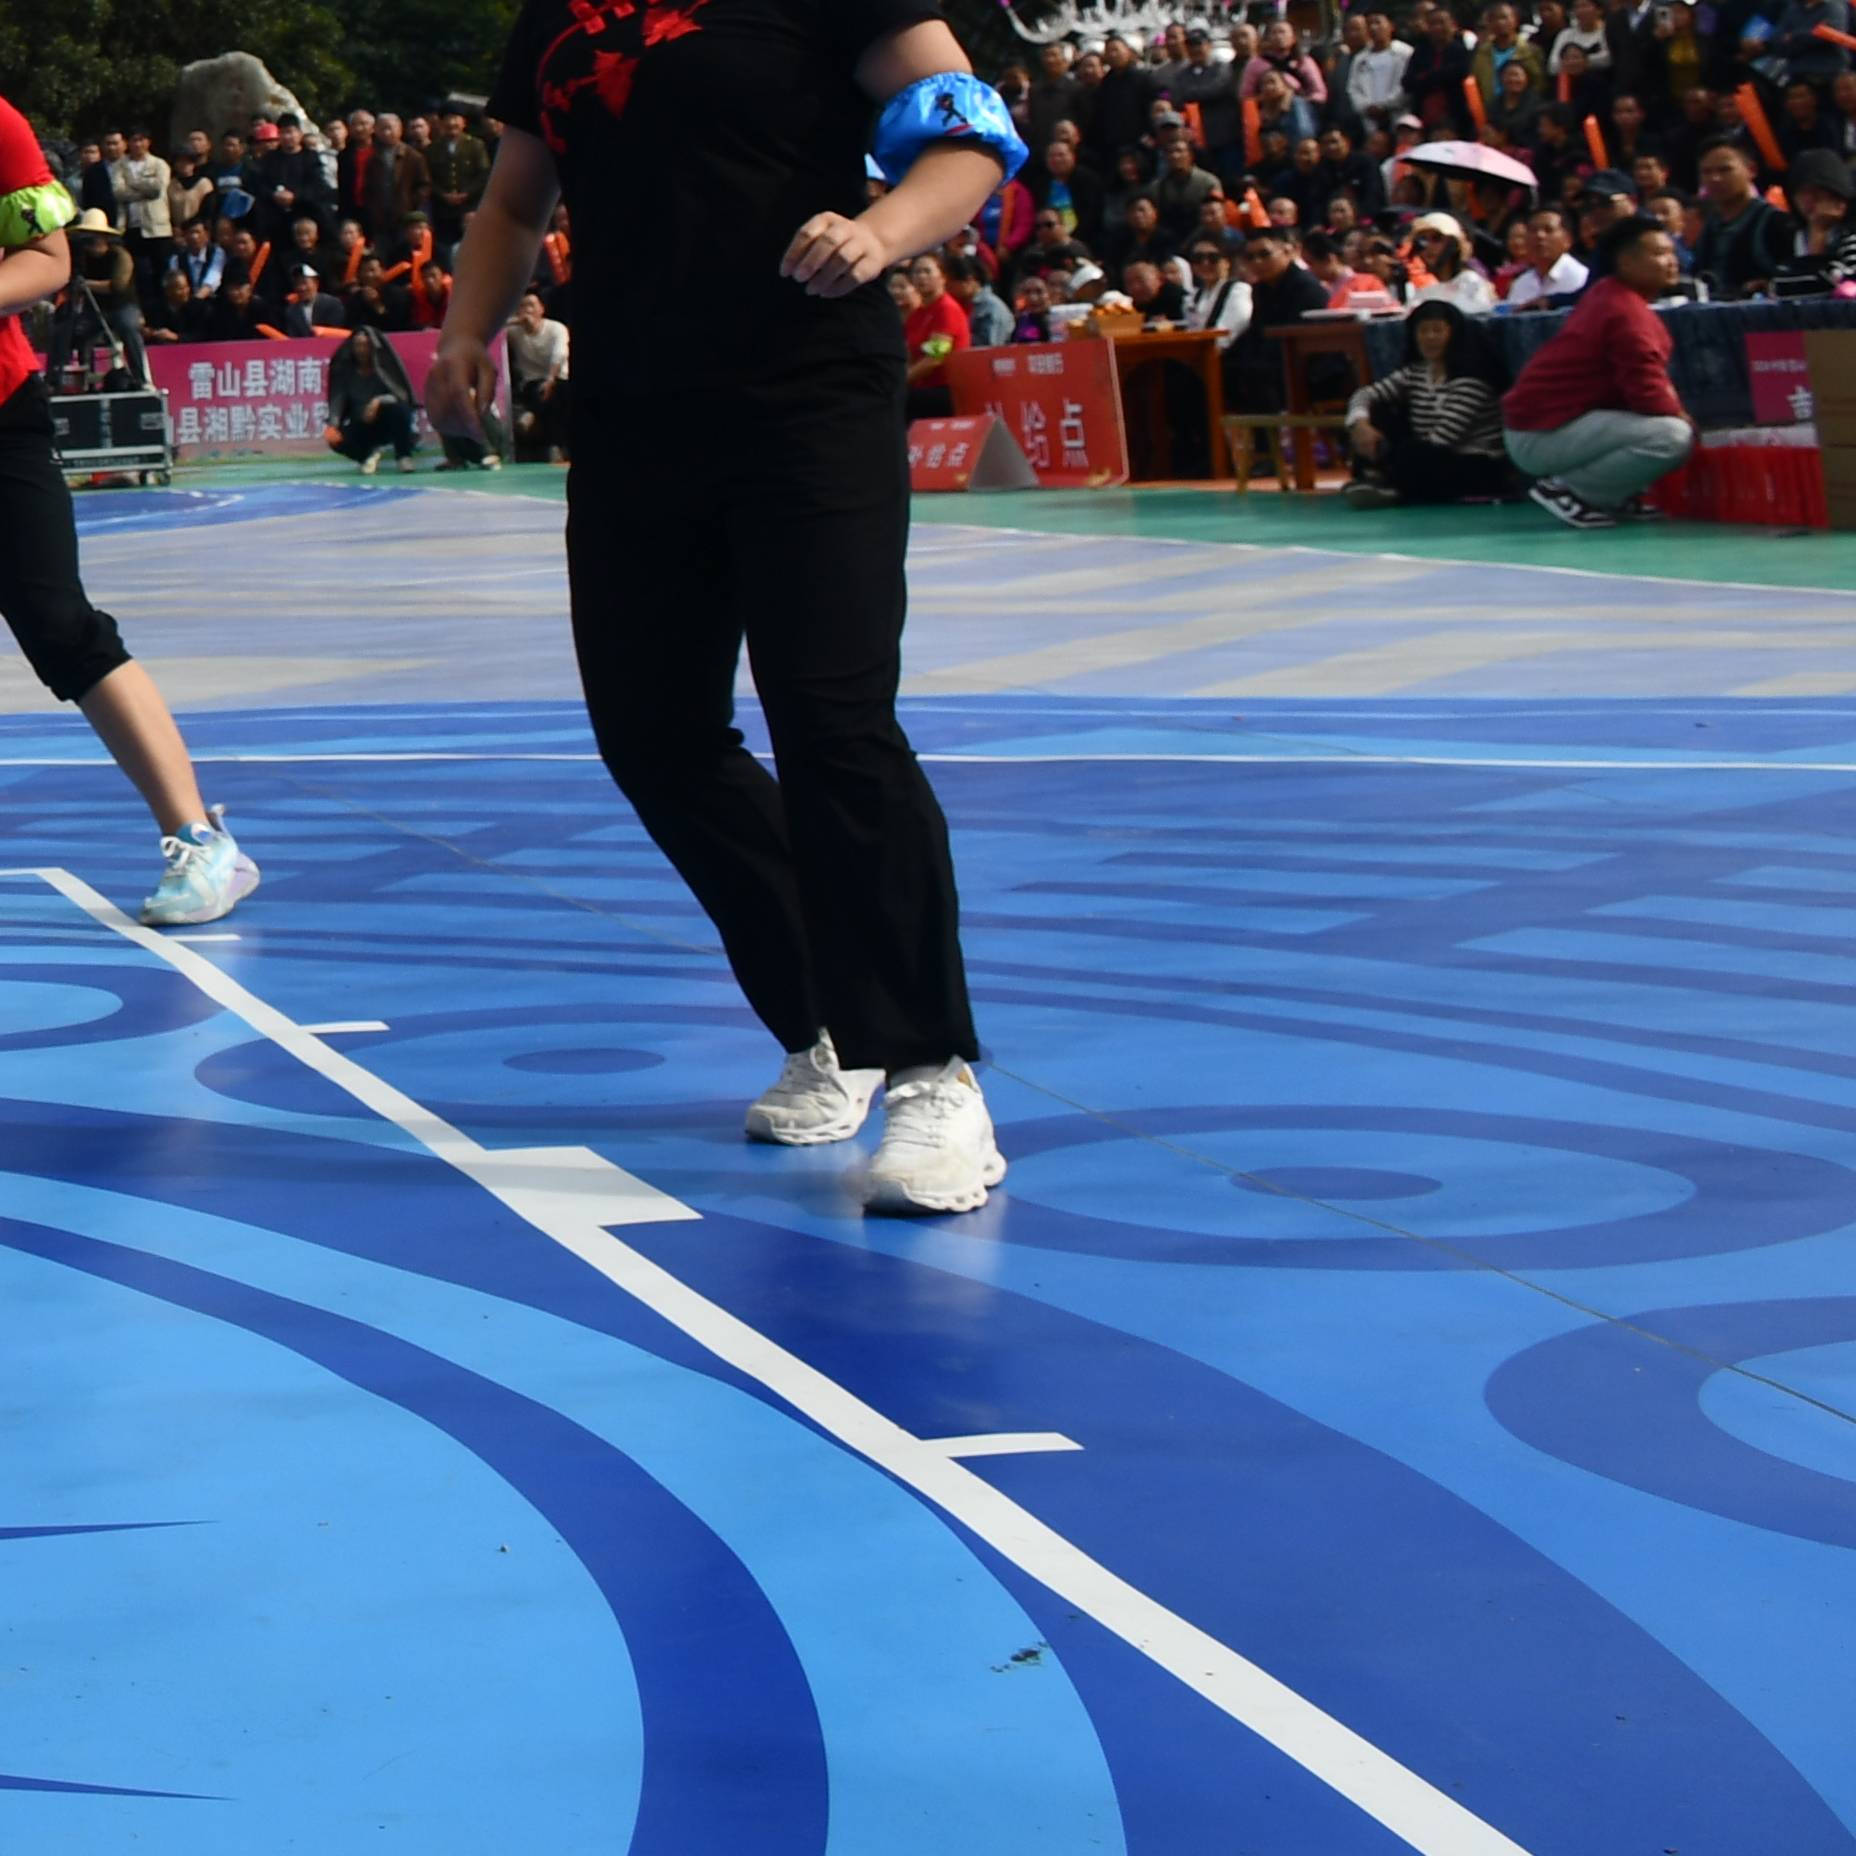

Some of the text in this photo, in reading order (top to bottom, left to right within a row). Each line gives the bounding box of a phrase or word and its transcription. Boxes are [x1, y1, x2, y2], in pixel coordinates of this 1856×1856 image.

[189, 357, 329, 400] 雷山县湖南
[985, 397, 1089, 468] 给点
